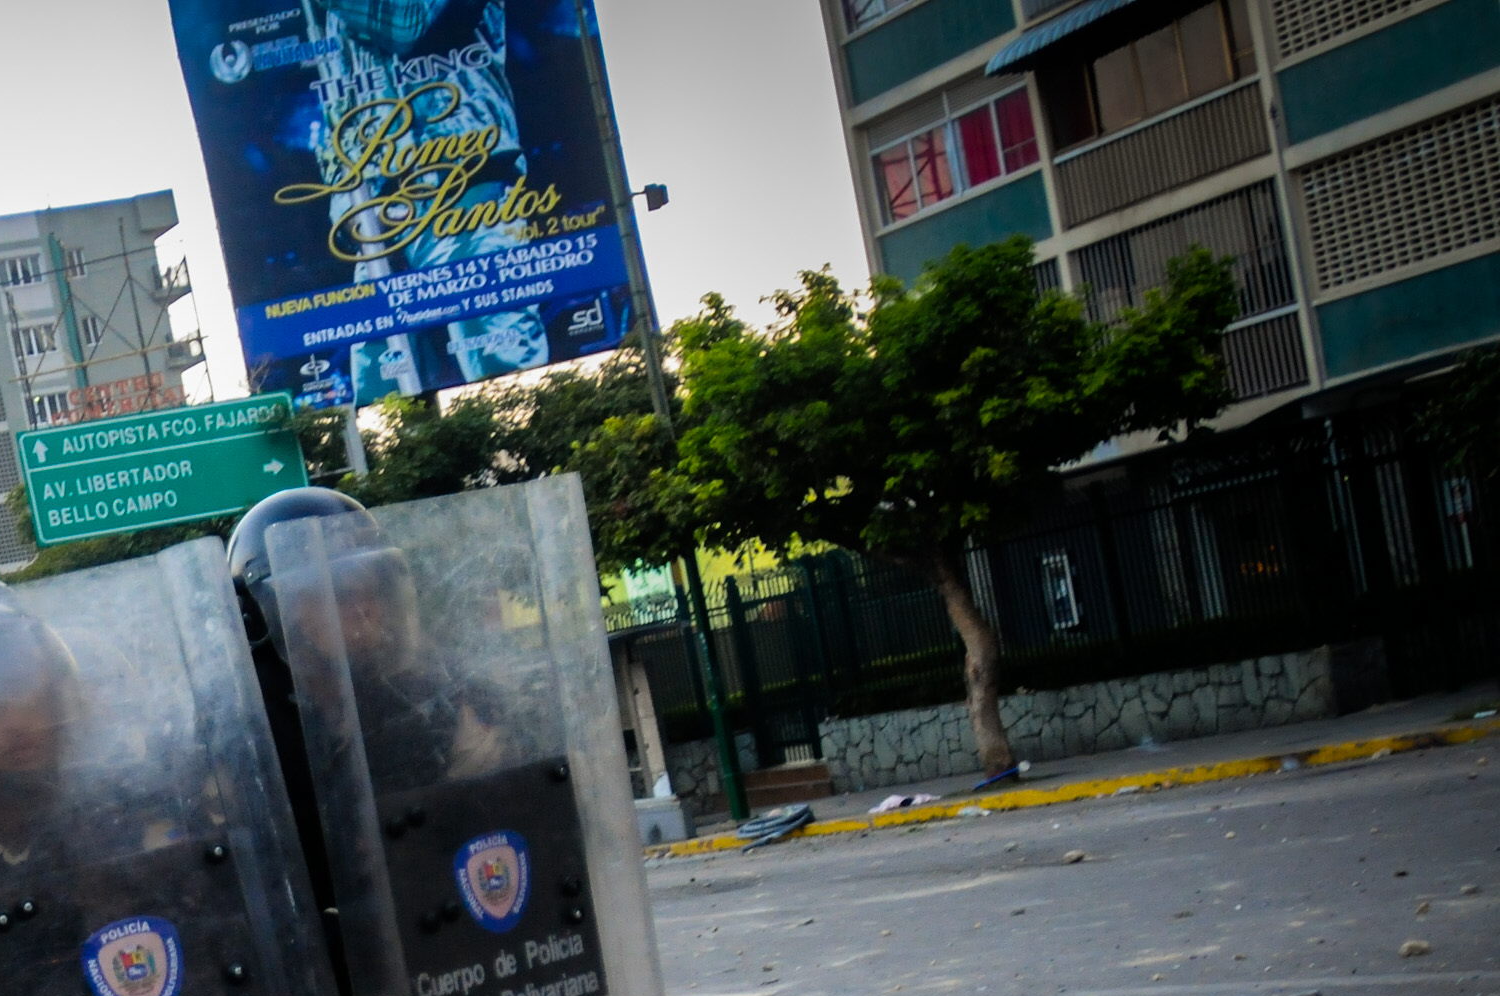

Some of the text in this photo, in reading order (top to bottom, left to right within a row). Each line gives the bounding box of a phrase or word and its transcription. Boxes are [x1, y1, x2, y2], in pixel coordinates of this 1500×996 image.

[228, 8, 301, 32] PRESENTADO
[255, 21, 280, 34] POR
[310, 43, 494, 102] THE KING
[274, 82, 500, 205] Romeo
[328, 153, 562, 260] Santos
[546, 216, 560, 235] 2
[265, 233, 598, 320] NUEVA FUNCIÓN VIERNES 14 Y SÁBADO 15
[388, 250, 594, 308] DE MARZO POLIEDRO
[303, 319, 373, 347] ENTRADAS
[375, 315, 394, 331] EN
[461, 298, 471, 311] Y
[474, 292, 499, 309] SUS
[501, 280, 554, 303] STANDS
[63, 424, 157, 455] AUTOPISTA
[162, 417, 201, 438] FCO.
[44, 460, 192, 500] AV. LIBERTADOR
[48, 490, 177, 527] BELLO CAMPO
[100, 920, 150, 944] POLICÍA
[495, 949, 517, 978] de
